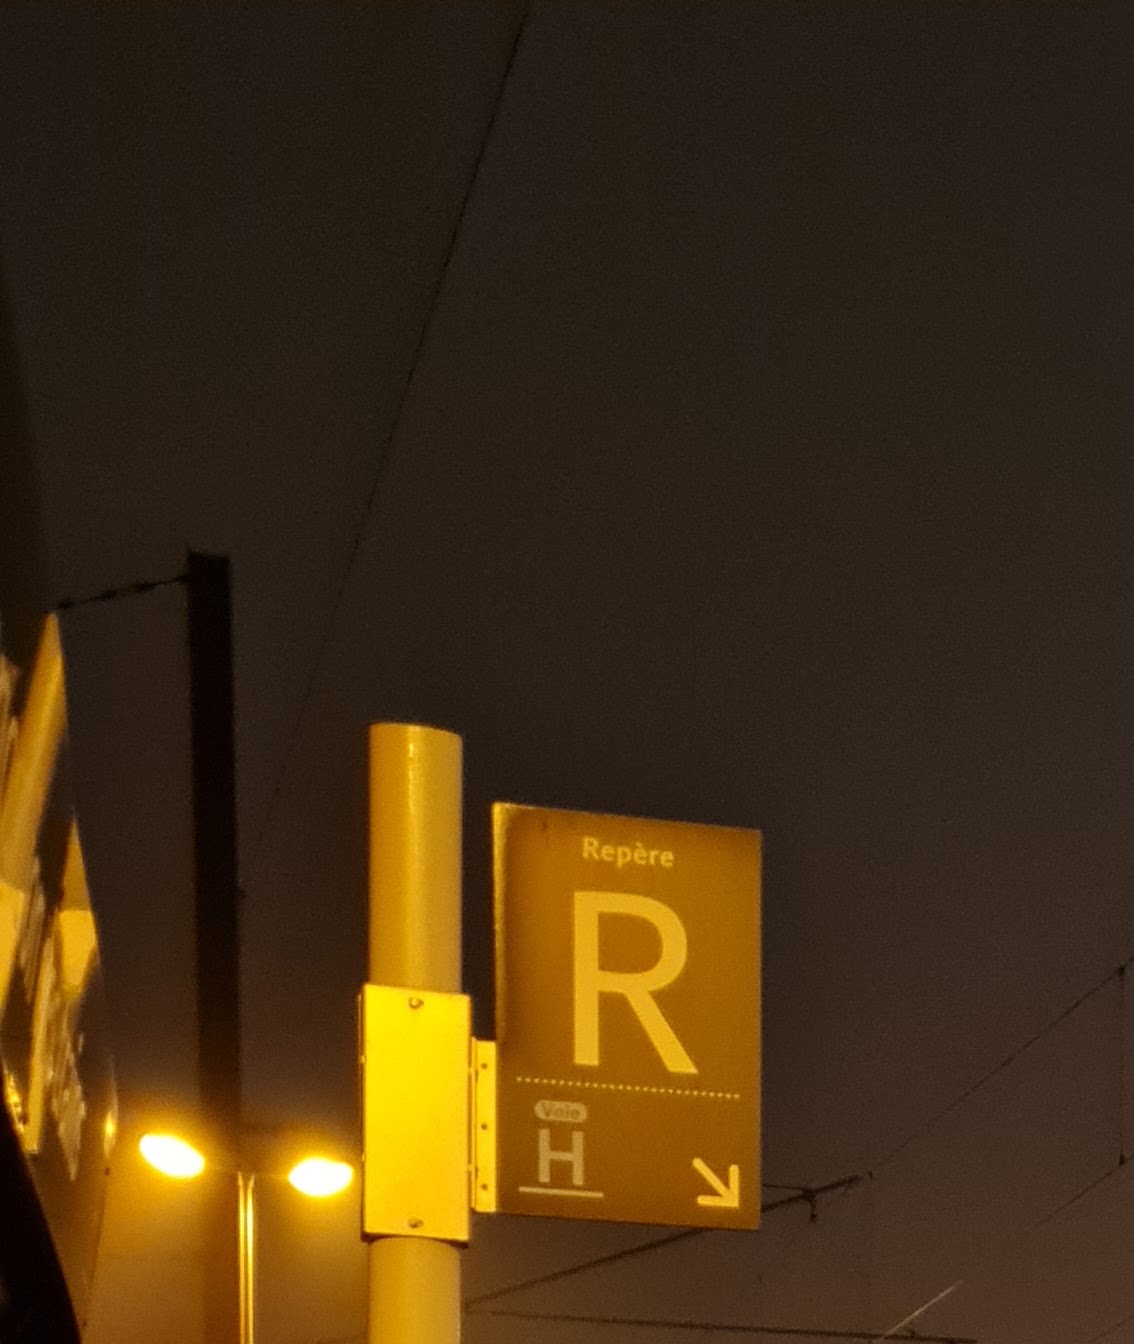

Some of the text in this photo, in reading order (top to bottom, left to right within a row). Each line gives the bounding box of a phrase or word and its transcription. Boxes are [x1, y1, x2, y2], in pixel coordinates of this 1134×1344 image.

[582, 836, 675, 868] Repère
[574, 890, 699, 1075] R
[540, 1102, 581, 1118] Voie
[538, 1128, 583, 1186] H
